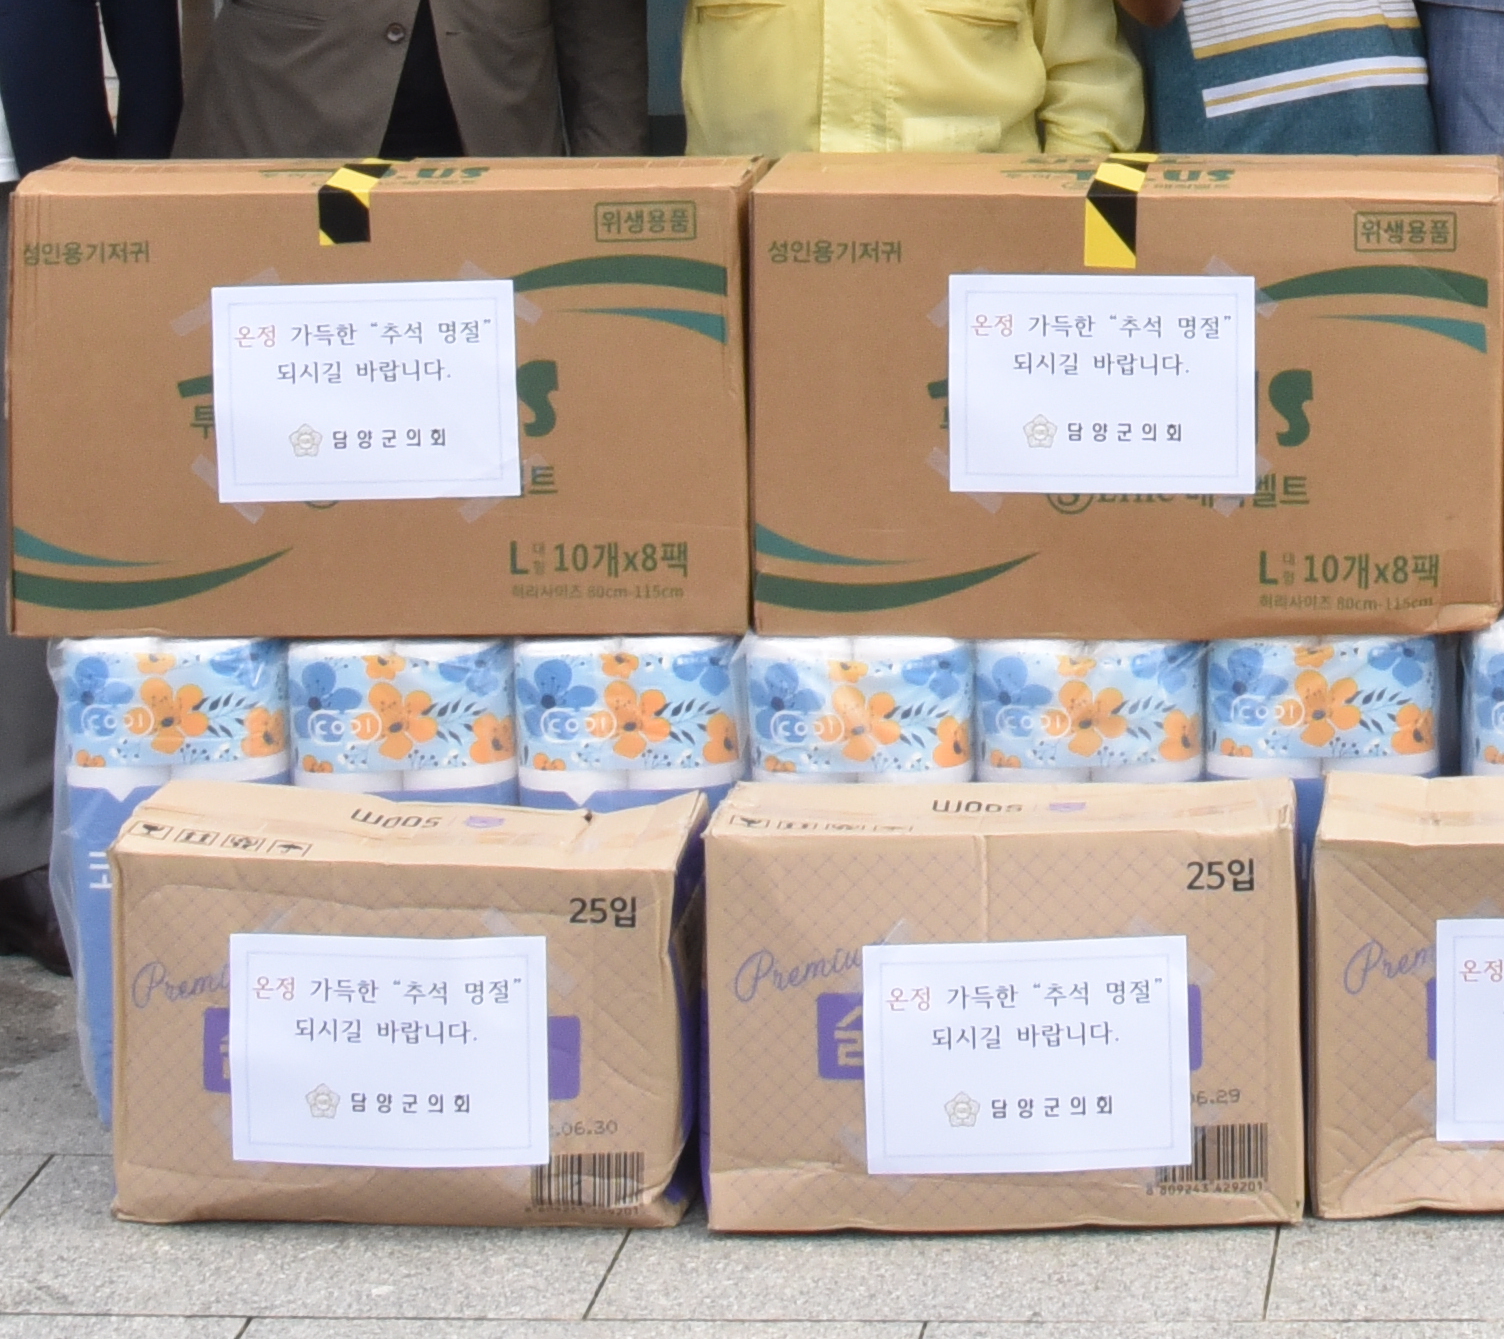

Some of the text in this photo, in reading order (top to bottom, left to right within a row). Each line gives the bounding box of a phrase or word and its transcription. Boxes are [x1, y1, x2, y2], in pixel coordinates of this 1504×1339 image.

[600, 207, 691, 236] 위생용품
[1359, 218, 1451, 247] 위생용품
[22, 240, 150, 266] 성인용기저귀
[768, 239, 902, 264] 성인용기저귀
[234, 325, 275, 348] 온정
[292, 323, 357, 346] 가득한
[971, 314, 1012, 337] 온정
[1029, 315, 1095, 337] 가득한
[278, 359, 450, 384] 되시길 바랍니다.
[1014, 352, 1189, 376] 되시길 바랍니다.
[333, 428, 445, 449] 담양군의회
[1068, 423, 1181, 442] 담양군의회
[510, 540, 529, 575] L
[1259, 550, 1279, 585] L
[1187, 858, 1254, 892] 25입
[570, 896, 636, 928] 25입
[1460, 959, 1503, 982] 온정
[253, 976, 294, 1001] 온정
[311, 978, 378, 1003] 가득한
[887, 986, 930, 1011] 온정
[948, 984, 1017, 1010] 가득한
[296, 1018, 476, 1044] 되시길 바랍니다.
[933, 1021, 1118, 1050] 되시길 바랍니다.
[351, 1093, 470, 1114] 담양군의회
[991, 1096, 1112, 1119] 담양군의회
